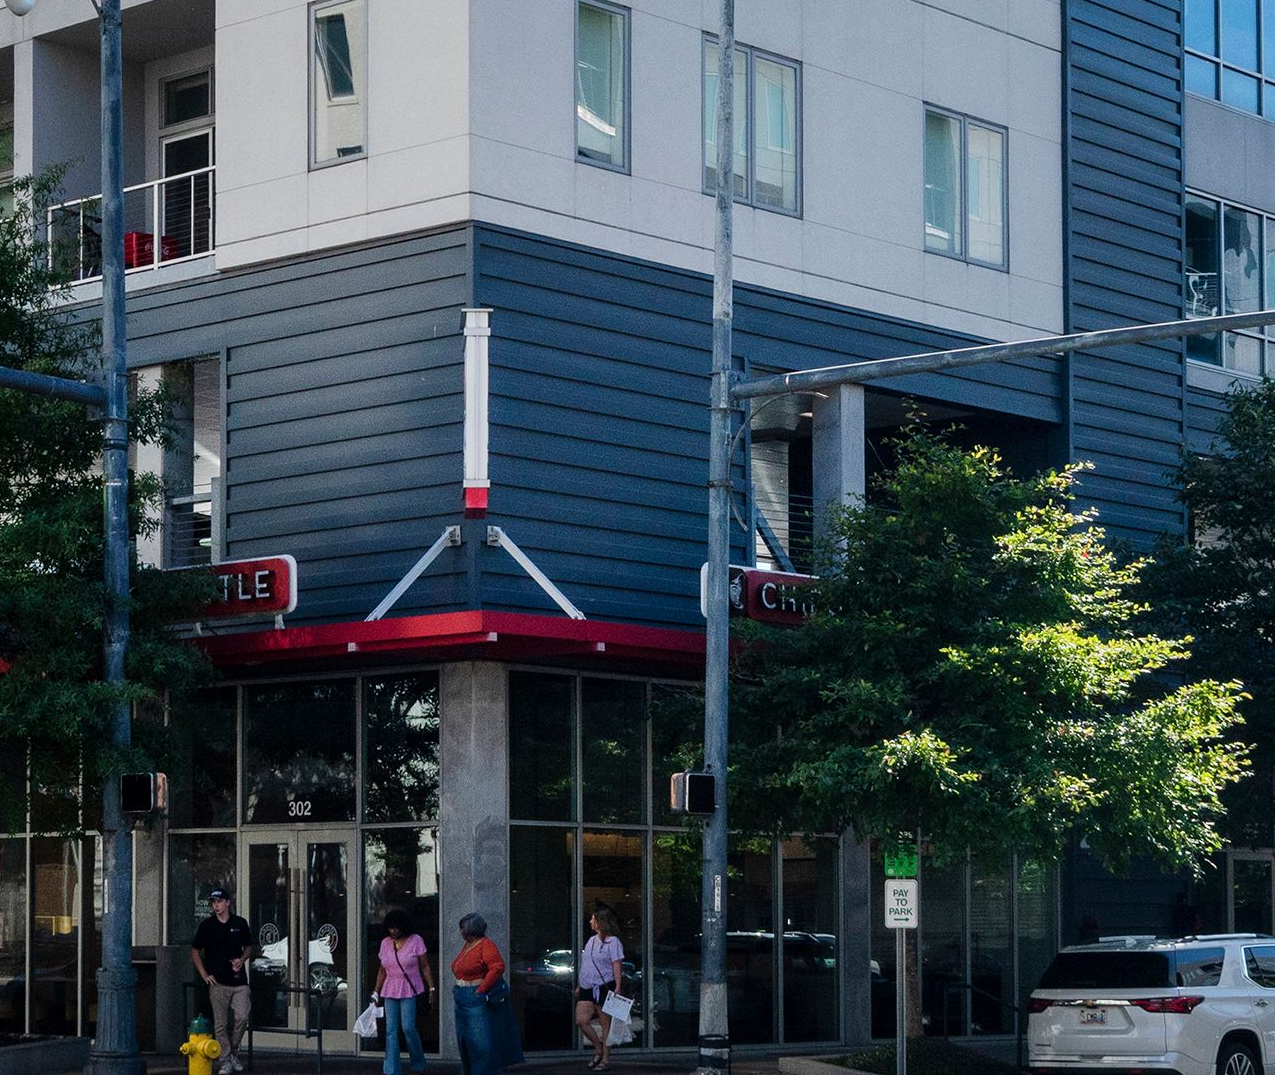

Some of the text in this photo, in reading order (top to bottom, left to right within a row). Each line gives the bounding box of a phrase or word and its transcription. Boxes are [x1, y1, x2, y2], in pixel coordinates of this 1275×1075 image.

[288, 800, 312, 817] 302
[893, 889, 909, 897] PAY
[895, 898, 908, 907] TO
[889, 908, 913, 916] PARK
